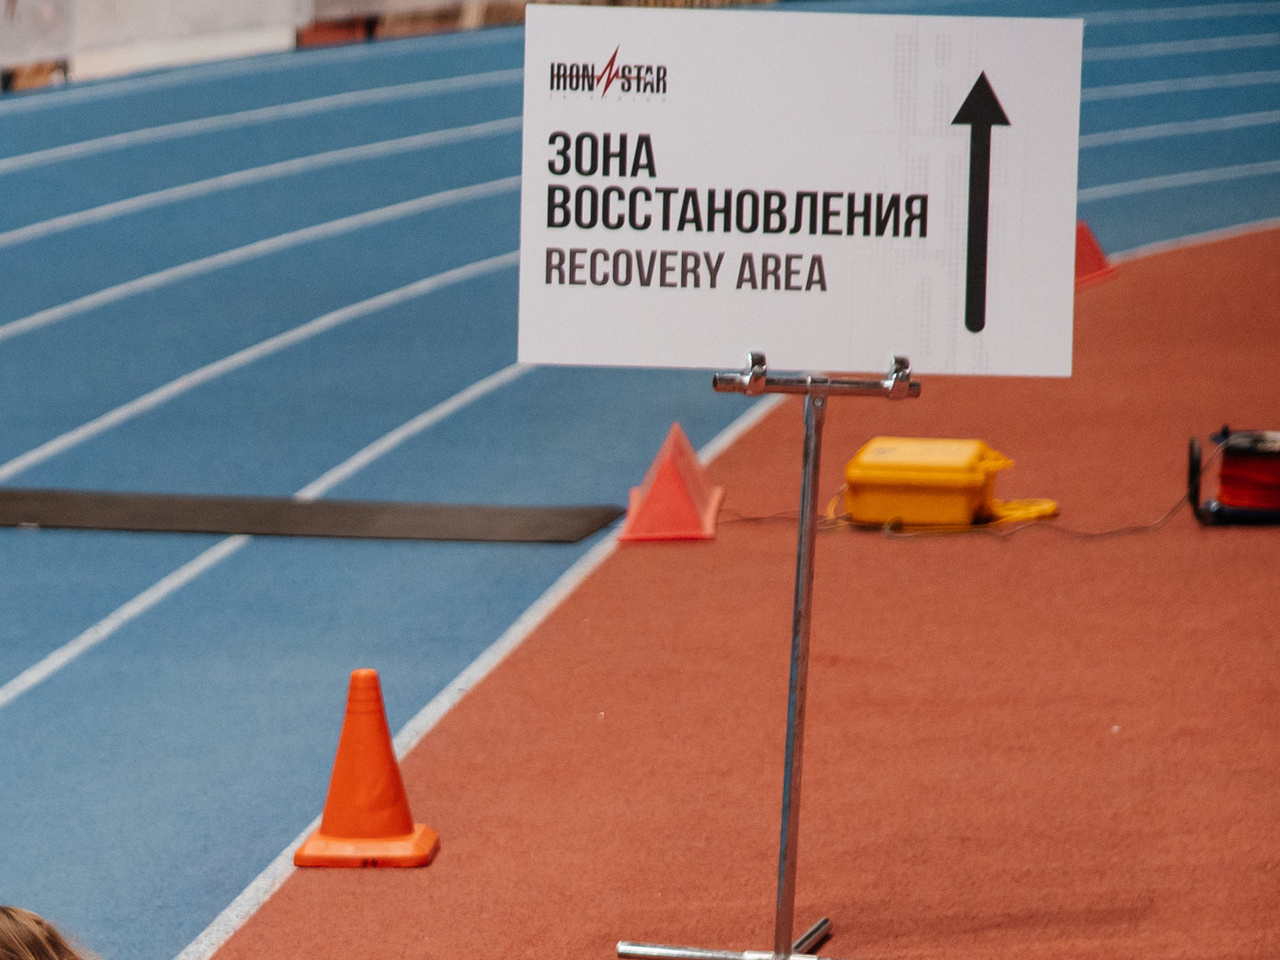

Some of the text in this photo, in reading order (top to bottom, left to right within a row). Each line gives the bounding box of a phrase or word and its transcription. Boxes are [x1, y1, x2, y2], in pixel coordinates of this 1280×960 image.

[549, 62, 667, 93] IRON STAR
[547, 131, 657, 178] ЗОНА
[546, 184, 929, 239] ВОССТАНОВЛЕНИЯ
[545, 247, 827, 292] RECOVERY AREA
